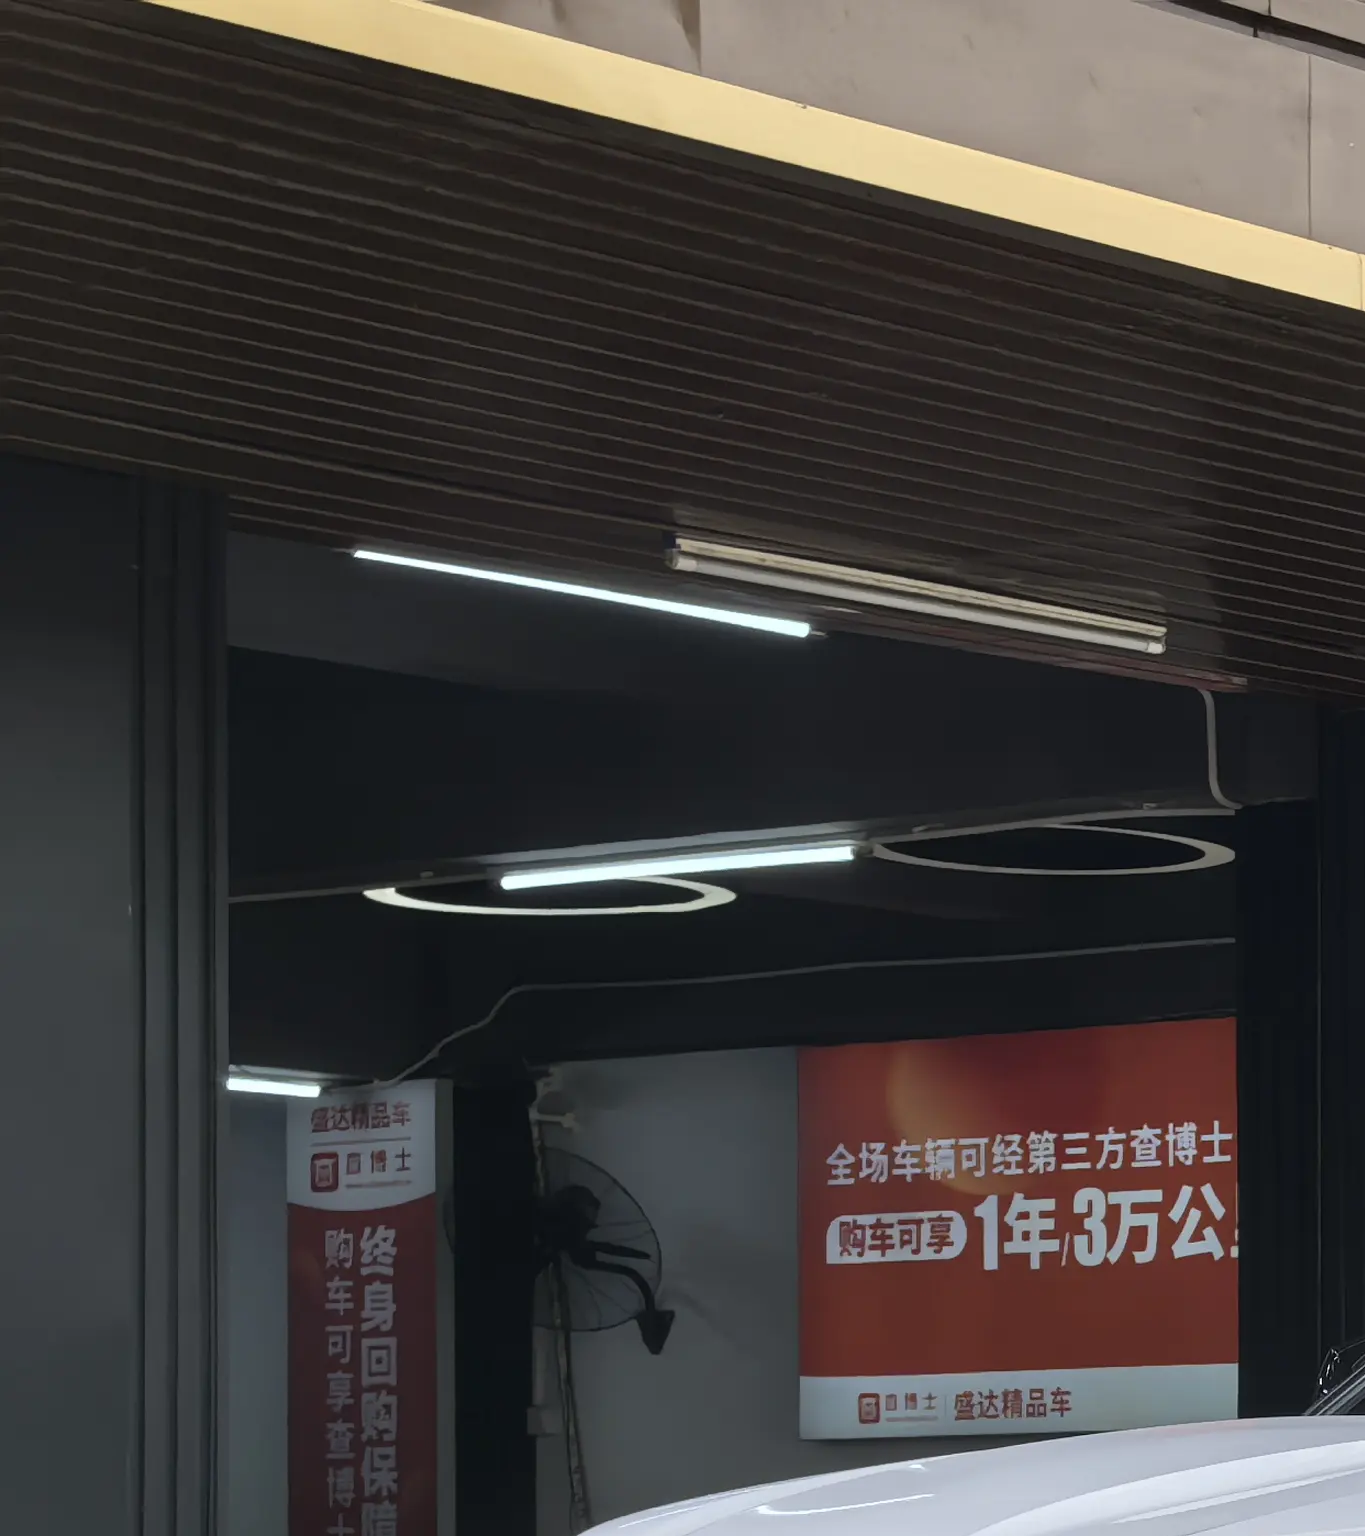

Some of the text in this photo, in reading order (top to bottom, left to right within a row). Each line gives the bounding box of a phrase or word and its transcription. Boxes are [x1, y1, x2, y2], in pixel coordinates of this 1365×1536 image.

[826, 1120, 1233, 1186] 全场车辆可经第三方查博士
[839, 1182, 1239, 1271] 购车可享 1年/3万公
[954, 1387, 1073, 1421] 盛达精品车
